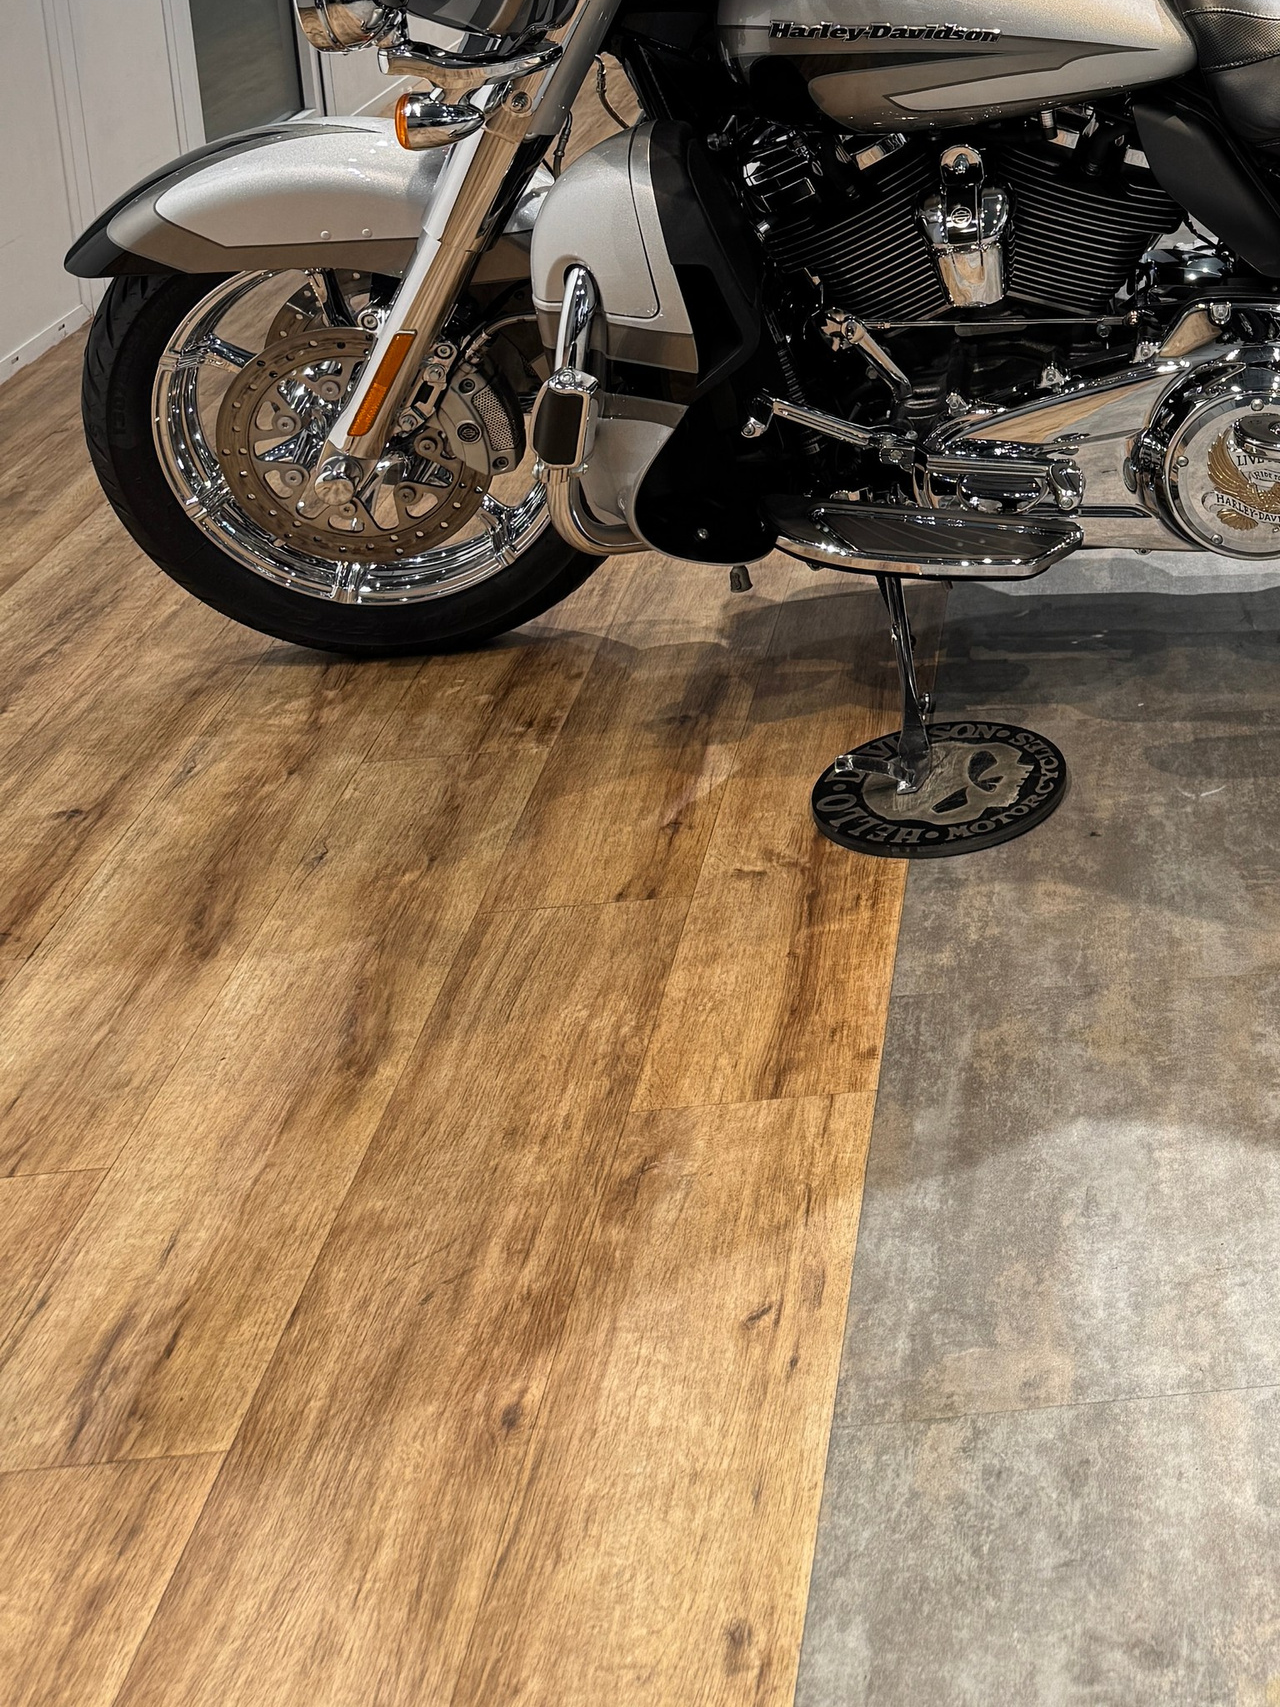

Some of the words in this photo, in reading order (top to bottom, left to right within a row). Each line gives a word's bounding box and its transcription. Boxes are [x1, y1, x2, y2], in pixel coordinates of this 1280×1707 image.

[768, 20, 1001, 42] Harley-Davidson
[816, 793, 926, 843] HELLO
[945, 732, 1060, 841] MOTORCYCLES
